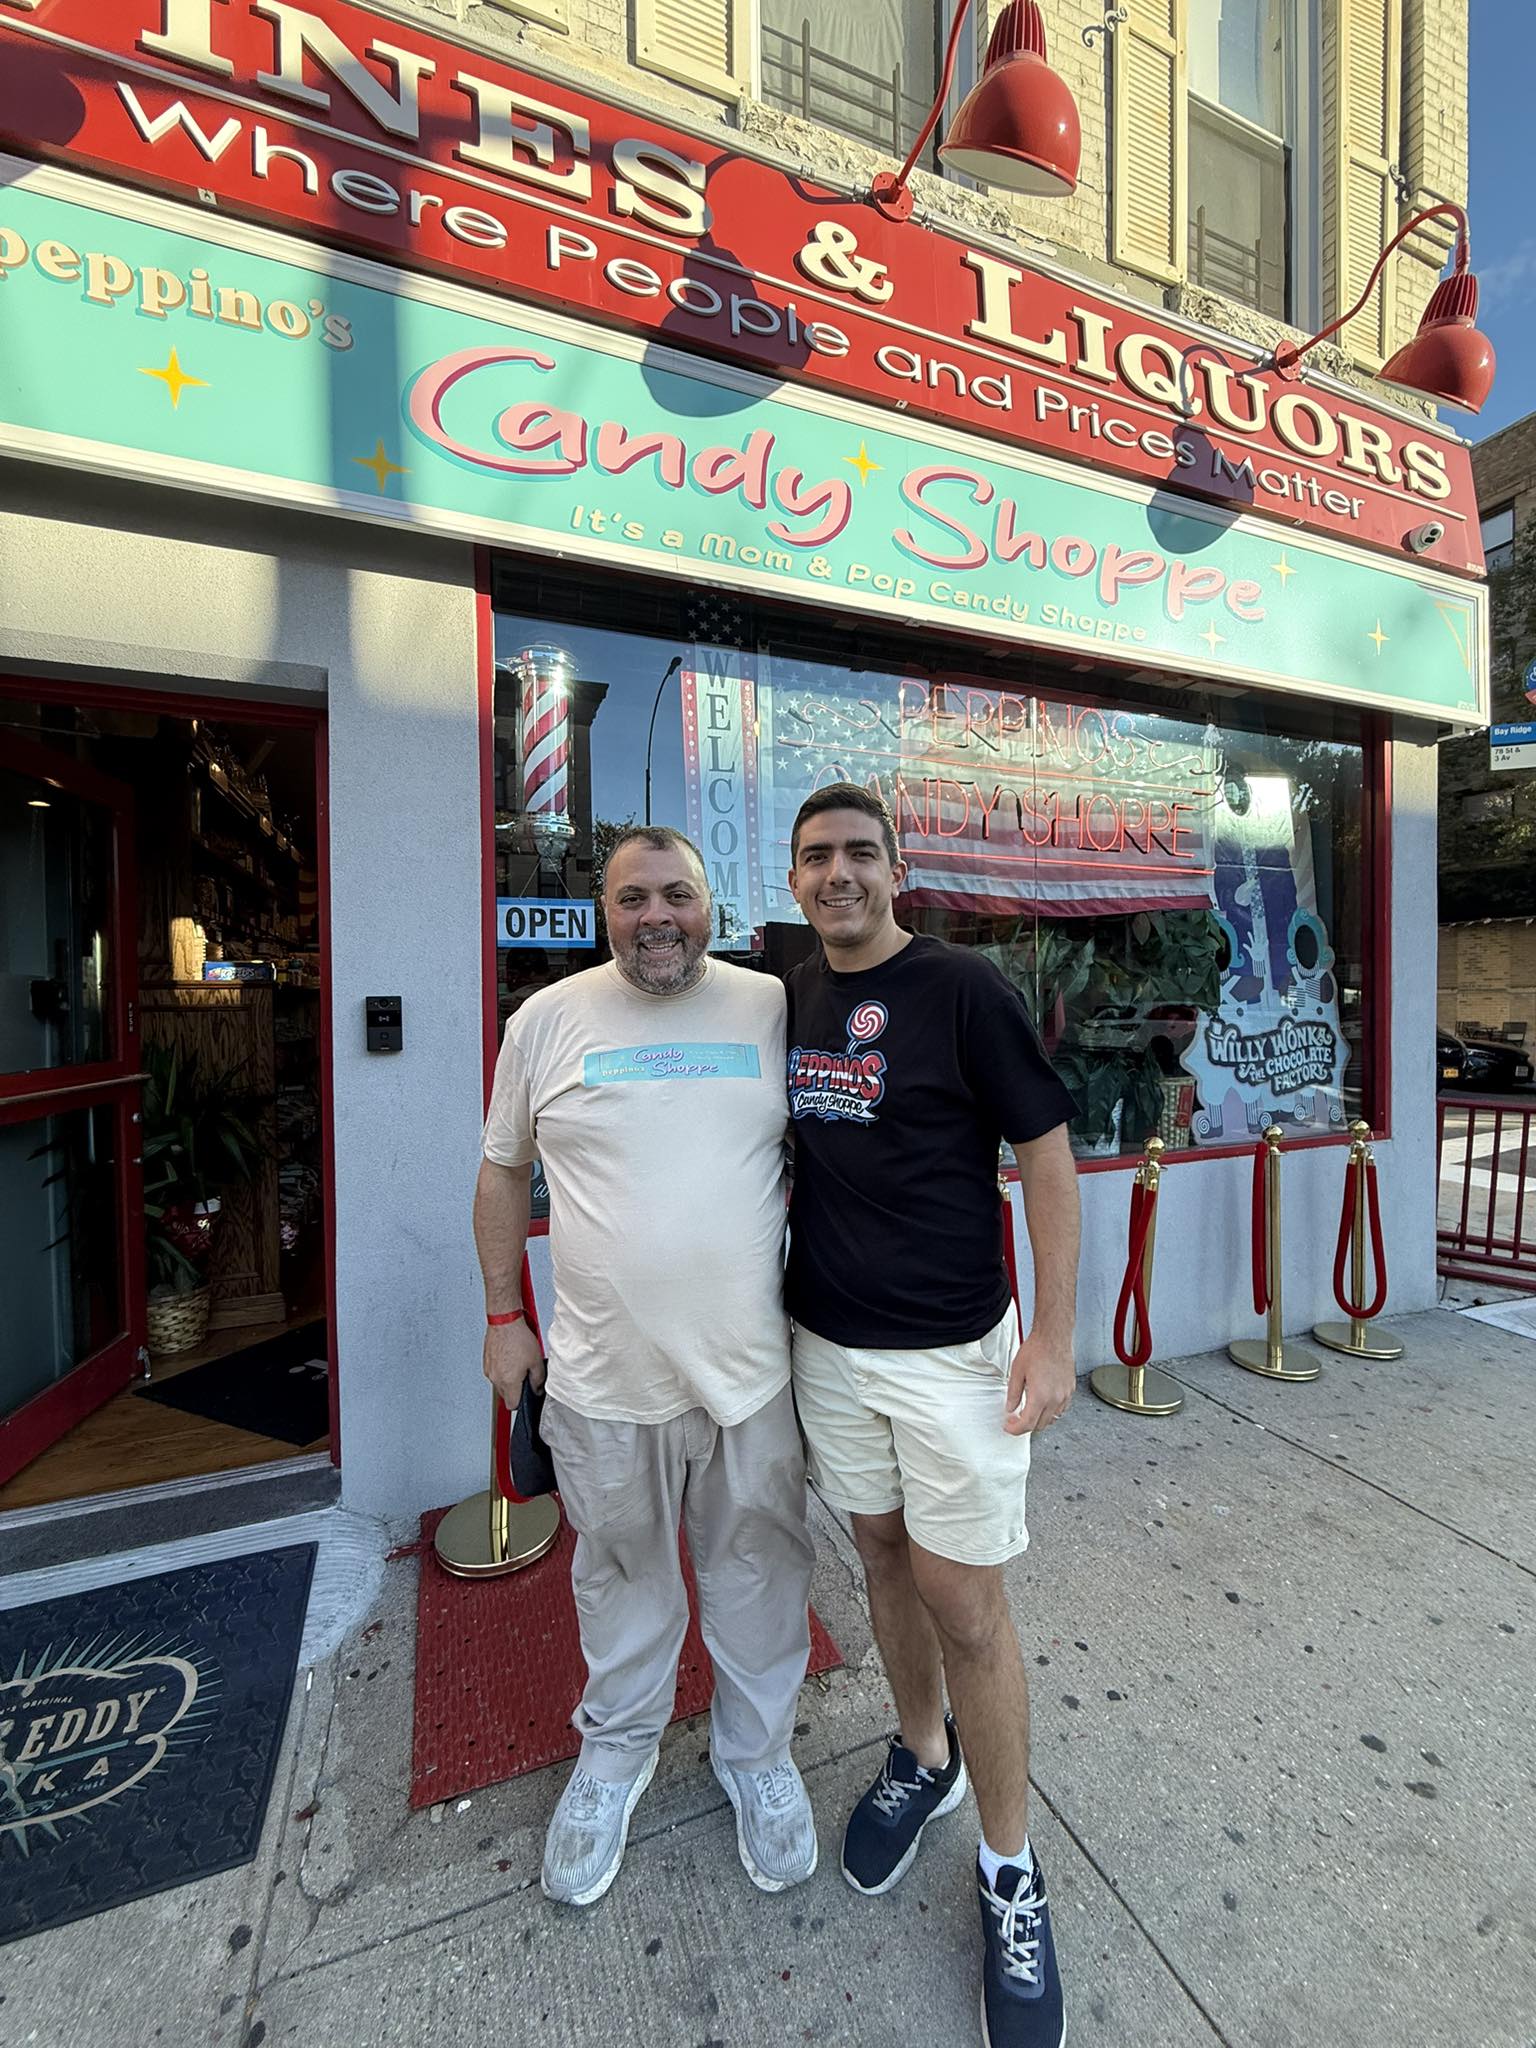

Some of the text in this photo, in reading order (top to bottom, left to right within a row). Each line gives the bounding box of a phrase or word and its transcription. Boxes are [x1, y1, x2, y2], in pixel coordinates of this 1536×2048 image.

[0, 0, 1451, 500] INES & LIQUORS
[116, 80, 1365, 520] Where People and Prices Matter
[405, 346, 1264, 622] Candy Shoppe
[571, 504, 1147, 642] It's a Mom & Pop Candy Shoppe
[1494, 725, 1532, 736] Bay Ridge
[702, 651, 741, 940] WELCOME
[1023, 785, 1196, 858] SHOPPE
[505, 907, 587, 939] OPEN
[632, 1047, 684, 1064] Candy
[1209, 1020, 1333, 1063] WILLY WONKA
[650, 1061, 720, 1078] Shoppe
[1265, 1046, 1333, 1077] CHOCOLATE
[1274, 1062, 1328, 1092] FACTORY
[797, 1092, 863, 1117] Candy Shoppe
[22, 1695, 74, 1710] ORIGINAL
[15, 1687, 157, 1762] EDDY
